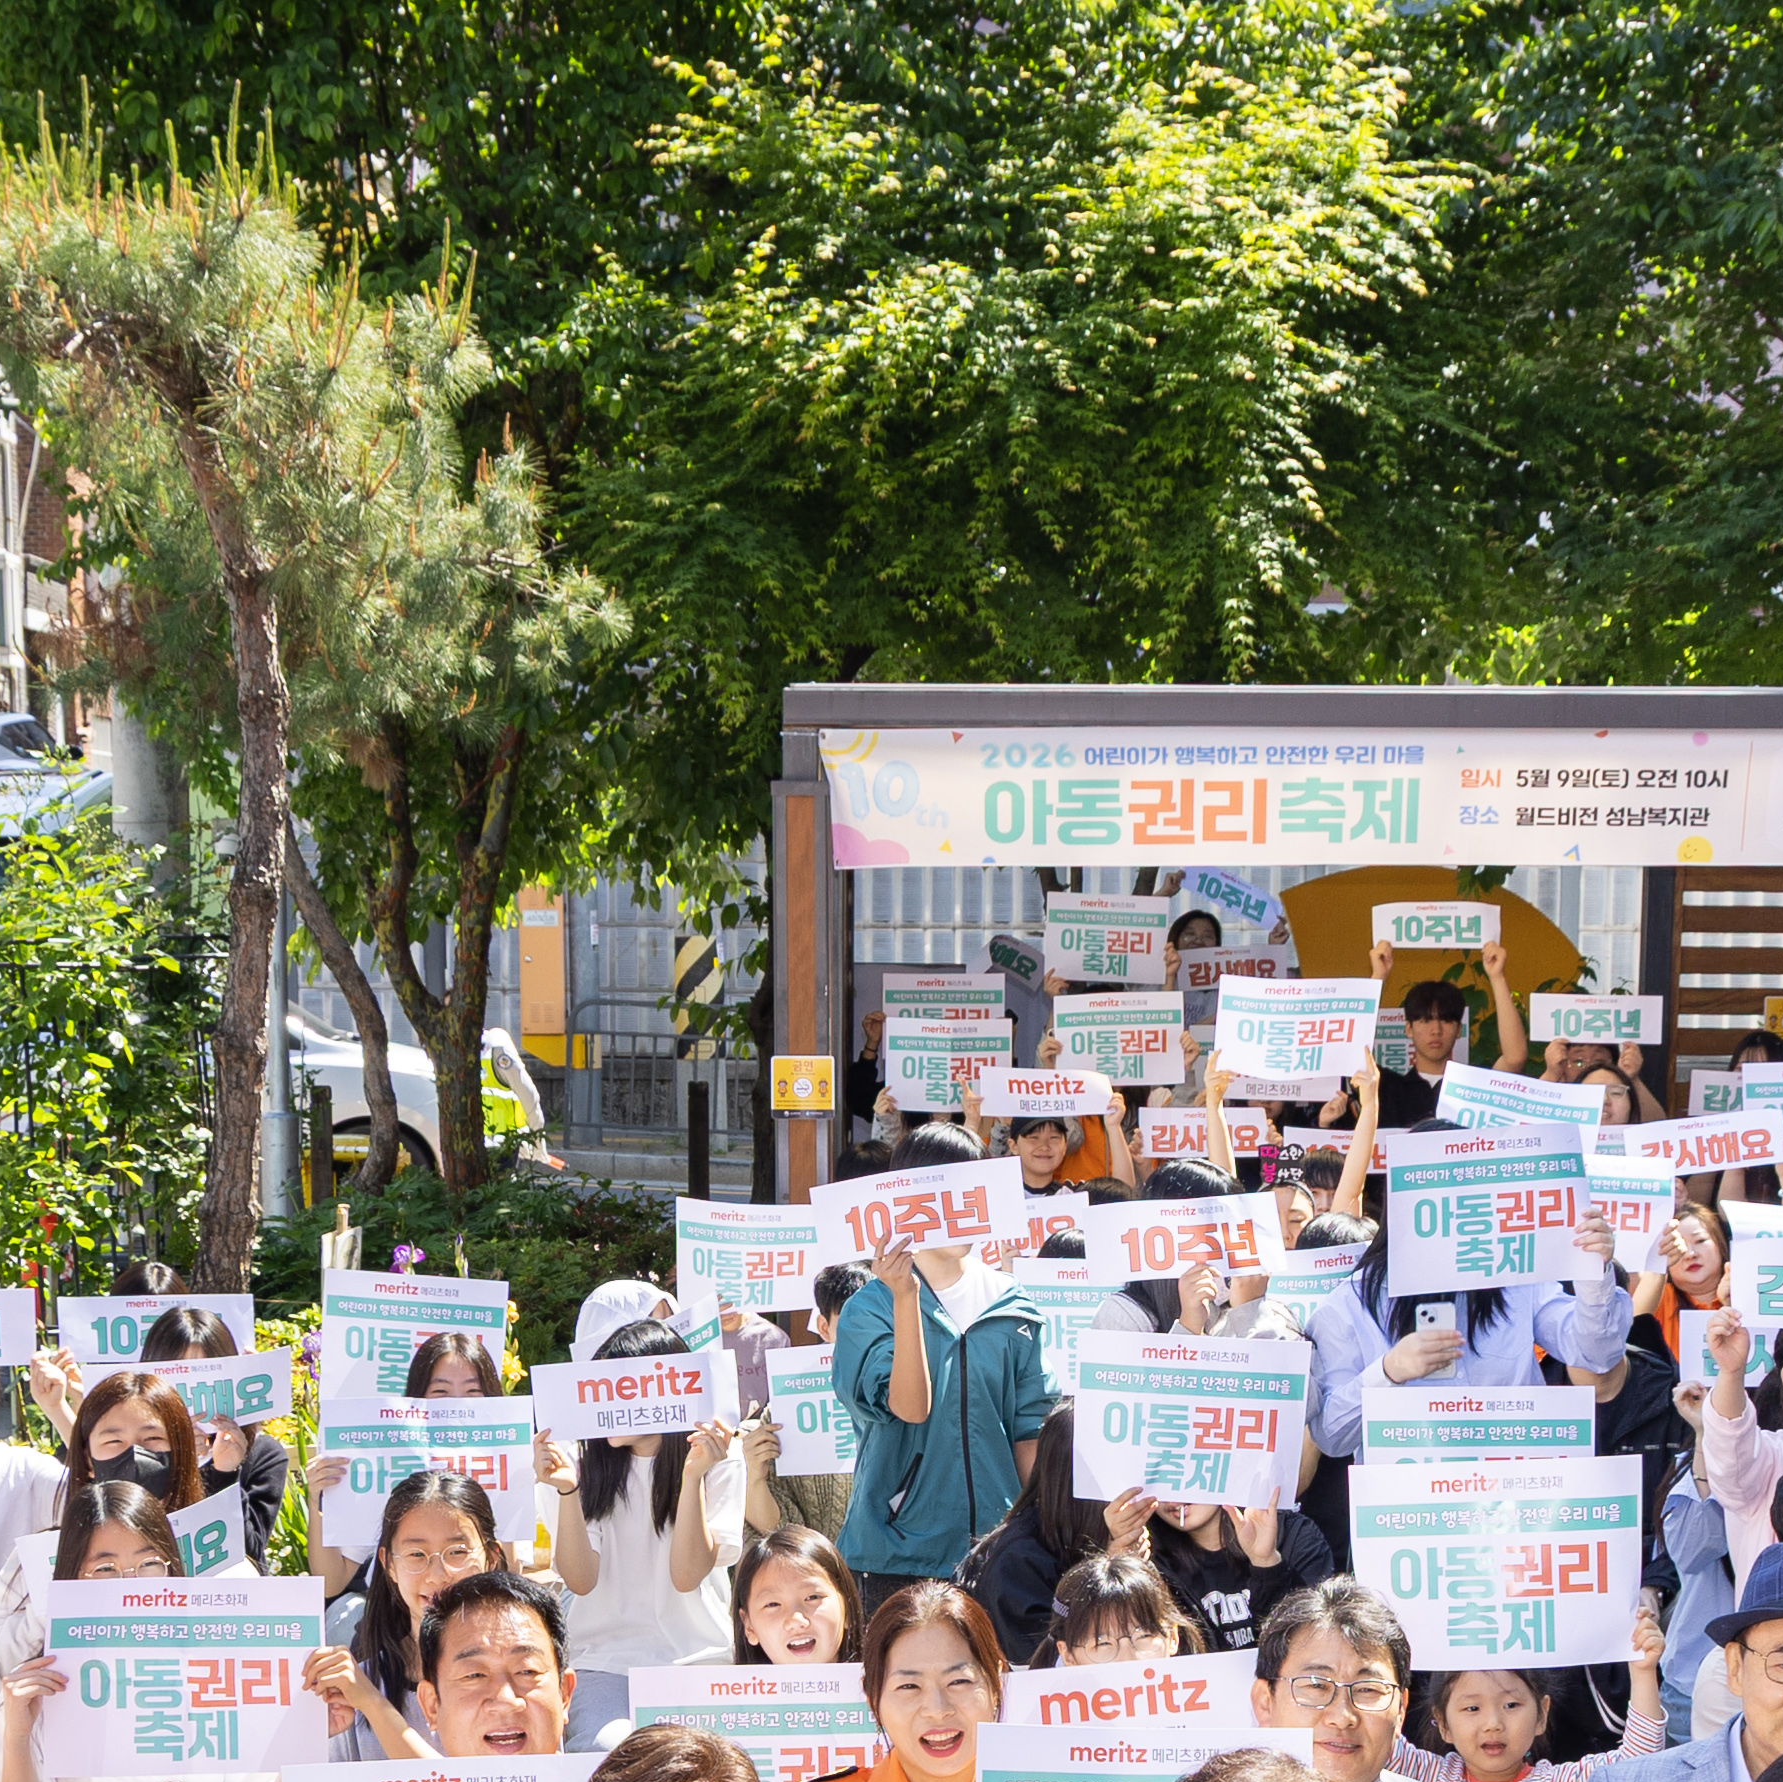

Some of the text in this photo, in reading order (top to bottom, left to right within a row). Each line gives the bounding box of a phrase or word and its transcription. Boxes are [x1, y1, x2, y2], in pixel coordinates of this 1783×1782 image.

[980, 742, 1424, 769] 2026 어린이가 행복하고 안전한 우리 마을
[1460, 768, 1728, 789] 일시 5월 9일(토) 오전 10시
[1458, 806, 1710, 827] 장소 월드비전 성남복지관
[1196, 871, 1267, 923] 10주년
[1060, 928, 1152, 954] 아동권리
[1391, 914, 1482, 944] 10주년
[1082, 953, 1128, 978] 축제
[1237, 1018, 1355, 1047] 아동권리
[1551, 1007, 1642, 1039] 10주년
[1070, 1029, 1167, 1056] 아동권리
[1096, 1054, 1144, 1079] 축제
[1264, 1044, 1323, 1073] 축제
[1008, 1075, 1085, 1095] meritz
[1019, 1099, 1076, 1112] 메리츠화재
[1444, 1137, 1542, 1155] meritz 메리츠화재
[845, 1186, 991, 1252] 10주년
[1414, 1187, 1576, 1239] 아동권리
[1120, 1219, 1261, 1272] 10주년
[1456, 1233, 1534, 1278] 축제
[576, 1361, 703, 1403] meritz
[597, 1403, 688, 1431] 메리츠화재
[1390, 1541, 1608, 1600] 아동권리
[122, 1588, 248, 1607] meritz 메리츠화재
[68, 1625, 302, 1641] 어린이가 행복하고 안전한 우리 마을
[1233, 1627, 1254, 1648] NBA
[1446, 1600, 1556, 1654] 축제
[79, 1658, 291, 1709] 아동권리
[1039, 1668, 1210, 1725] meritz
[134, 1710, 239, 1762] 축제
